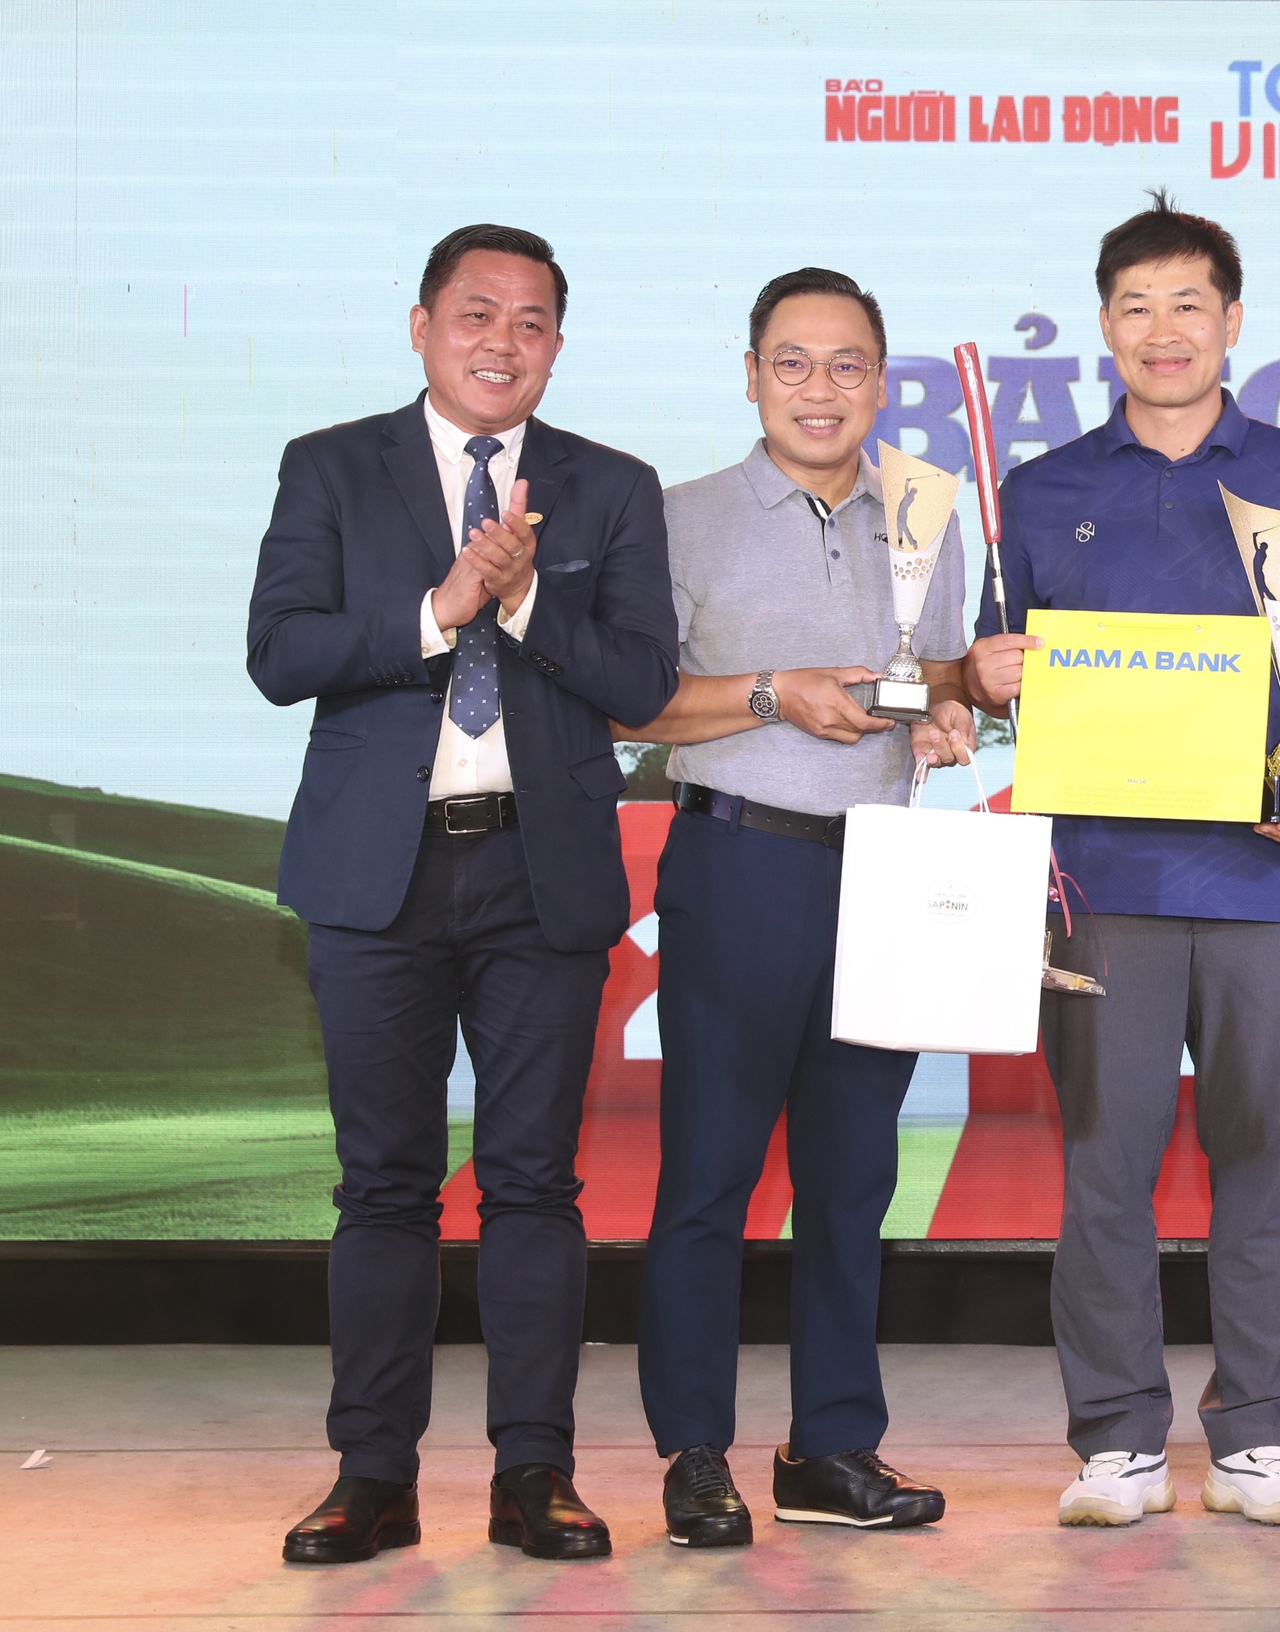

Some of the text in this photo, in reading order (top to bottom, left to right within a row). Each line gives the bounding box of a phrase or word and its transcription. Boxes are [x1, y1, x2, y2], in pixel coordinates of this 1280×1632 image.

[825, 91, 1179, 146] NGƯỜI LAO ĐỘNG
[1049, 648, 1242, 673] NAM A BANK
